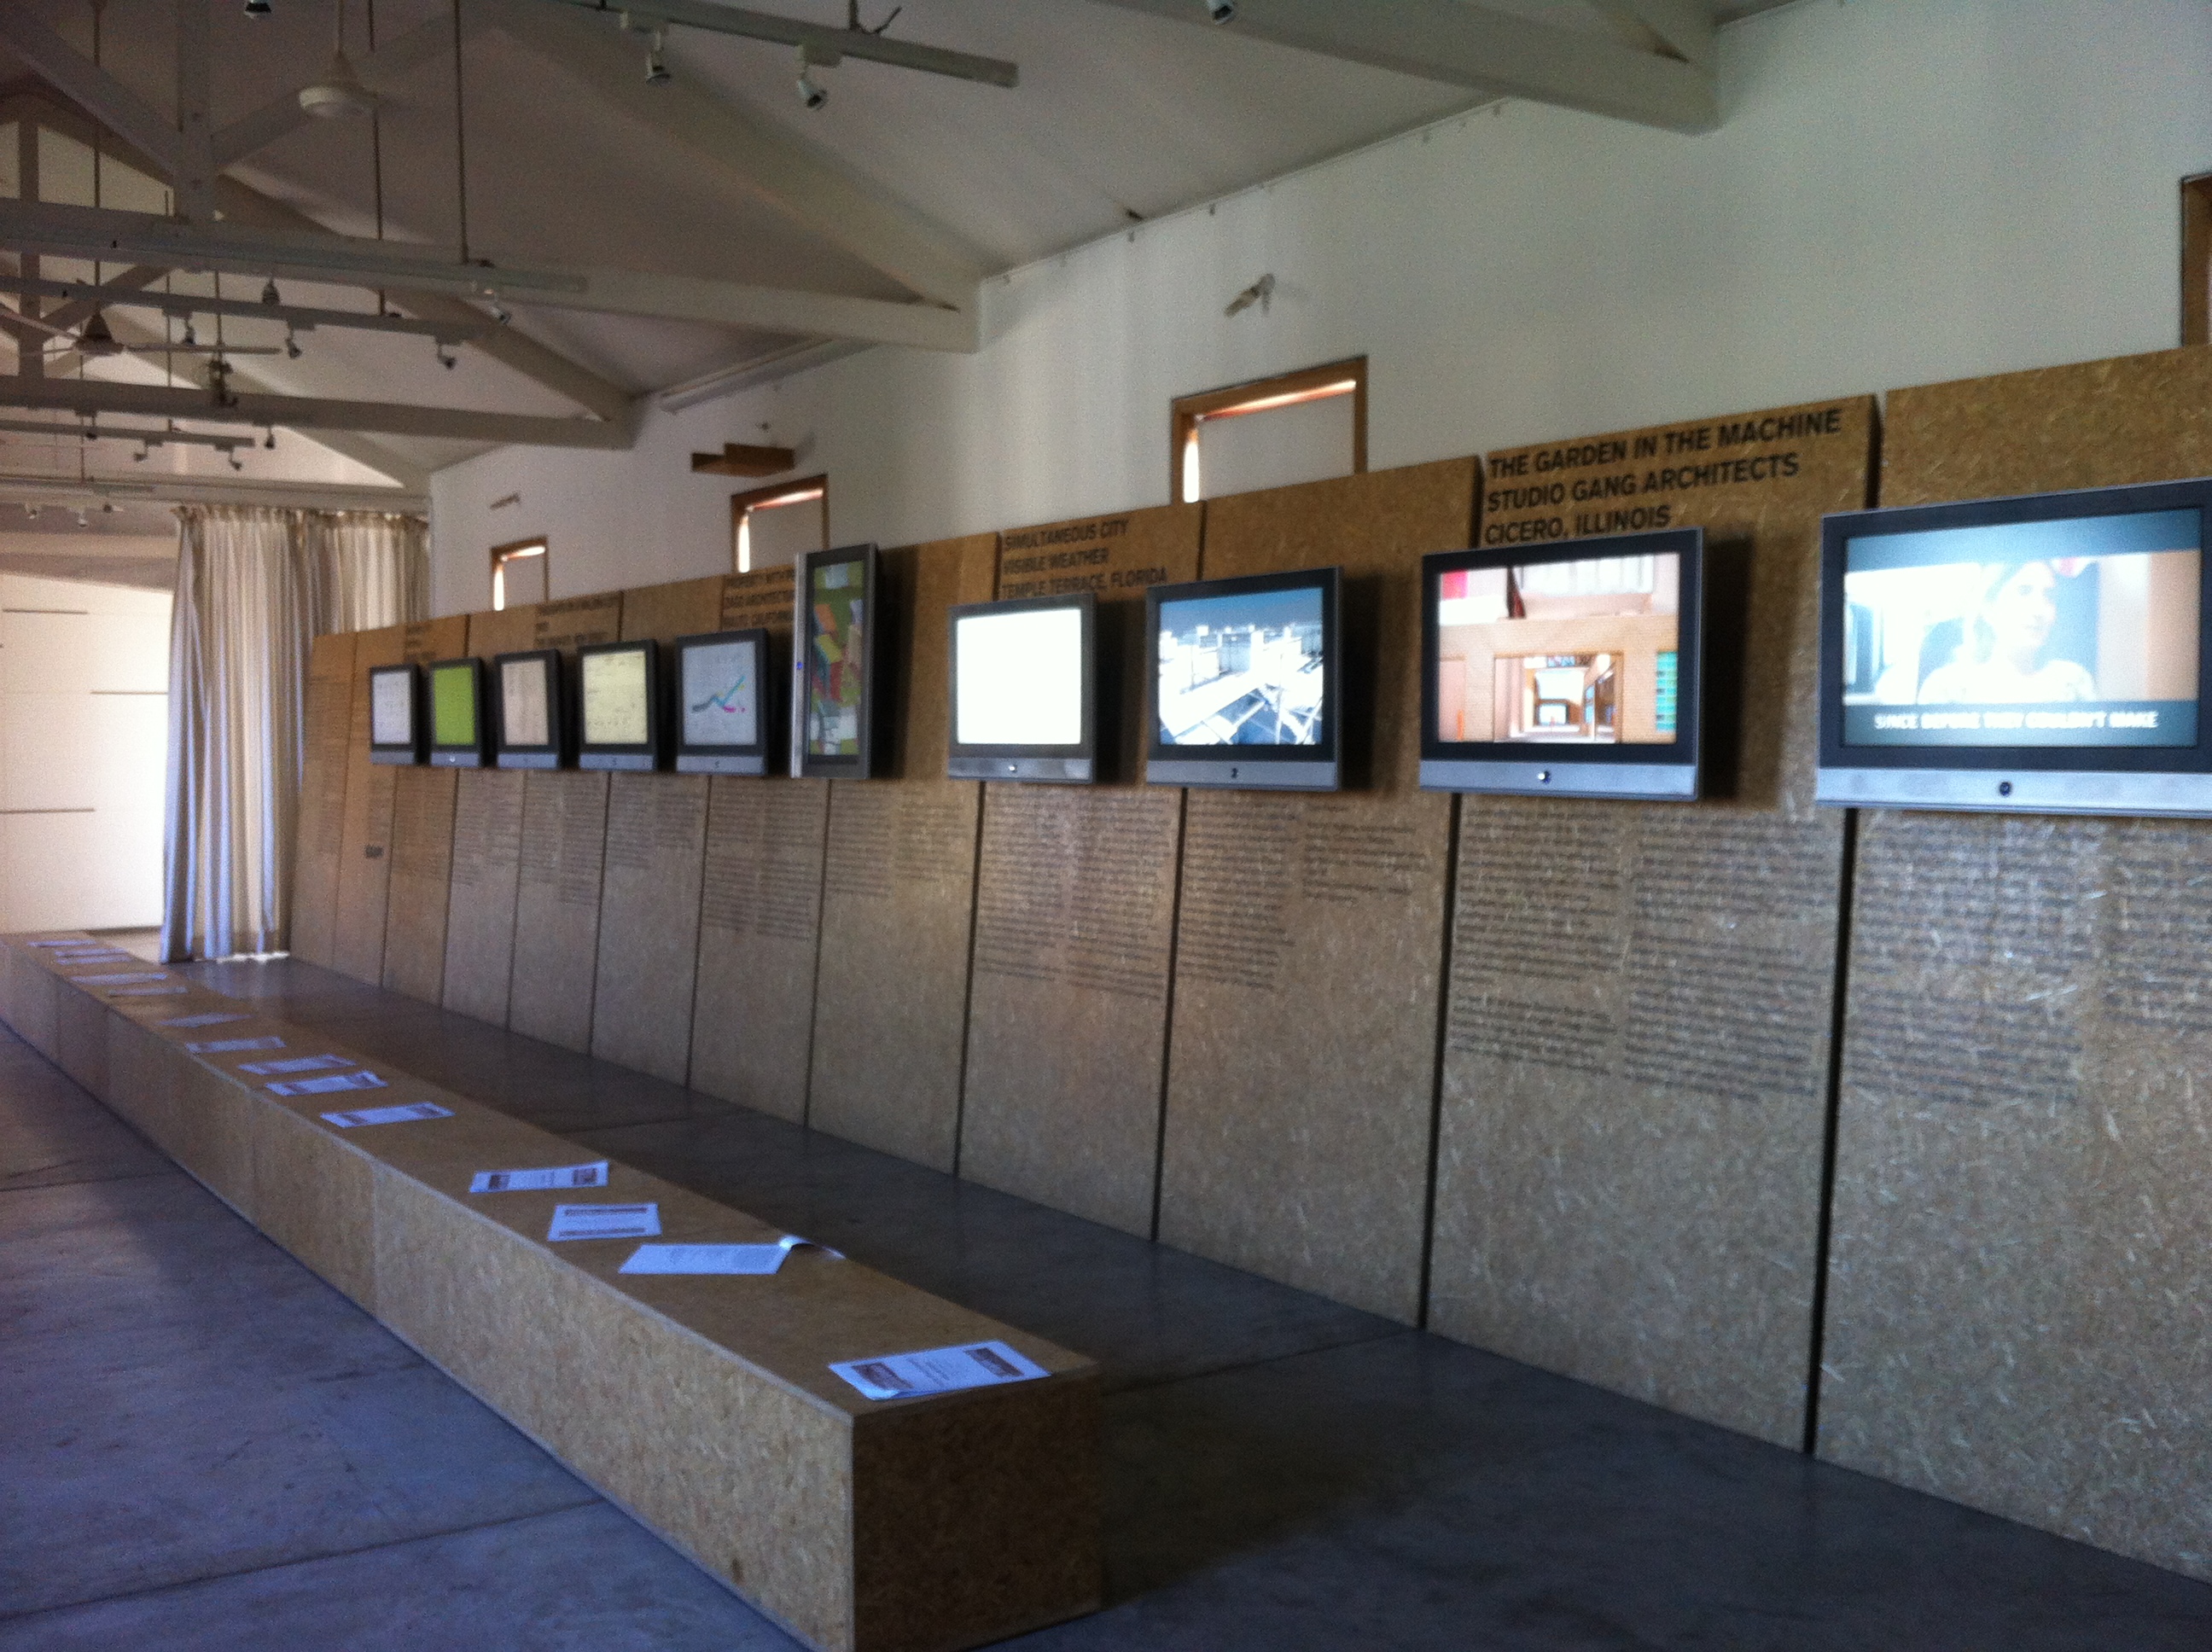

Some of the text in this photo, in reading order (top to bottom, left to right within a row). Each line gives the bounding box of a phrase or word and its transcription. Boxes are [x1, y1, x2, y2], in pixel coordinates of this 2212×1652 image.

[1490, 408, 1842, 478] THE GARDEN IN THE MACHINE
[1487, 451, 1799, 512] STUDIO GANG ARCHITECTS
[1485, 504, 1672, 545] CICERO, ILLINOIS
